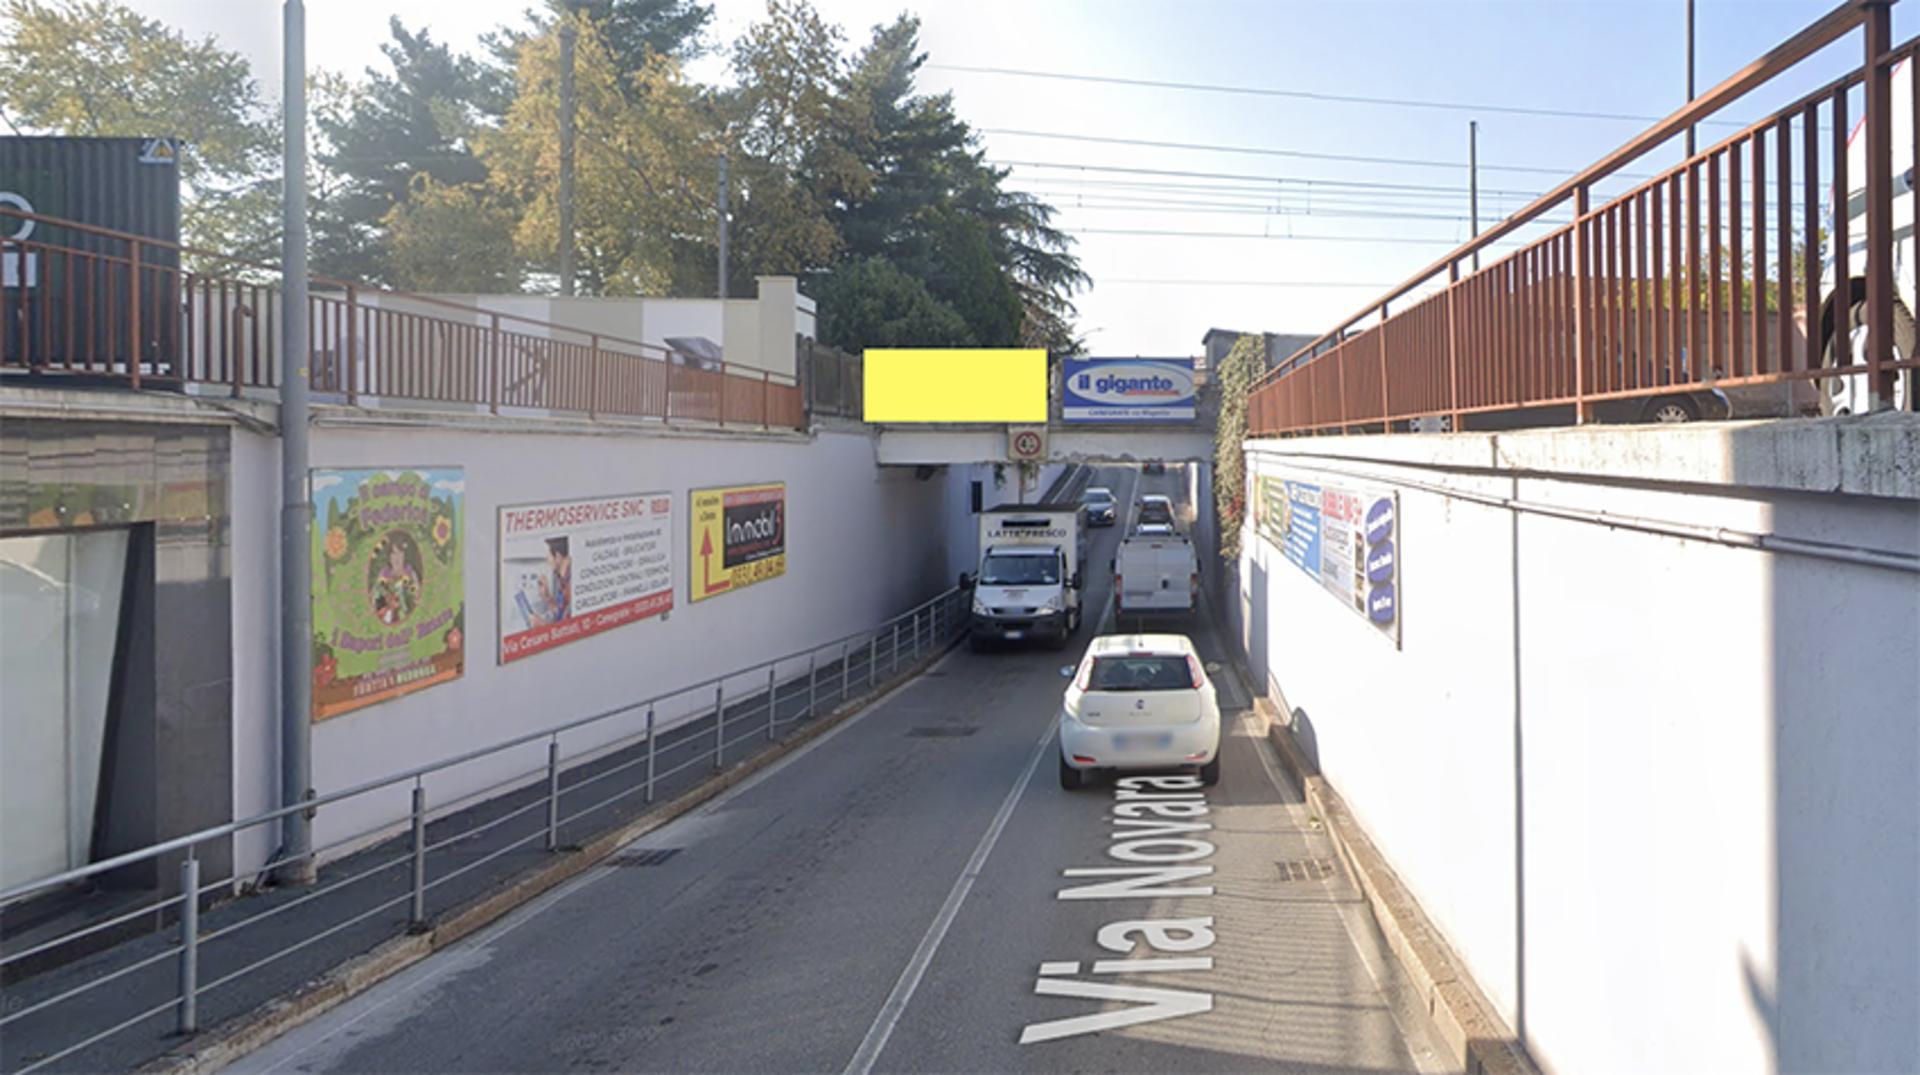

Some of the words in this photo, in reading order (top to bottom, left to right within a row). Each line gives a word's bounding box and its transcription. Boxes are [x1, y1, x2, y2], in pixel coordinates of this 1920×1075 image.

[1078, 374, 1091, 389] il
[1096, 374, 1173, 394] gigante
[504, 501, 620, 533] THERMOSERVICE
[622, 499, 645, 518] SNC
[1025, 528, 1067, 538] FRESCO
